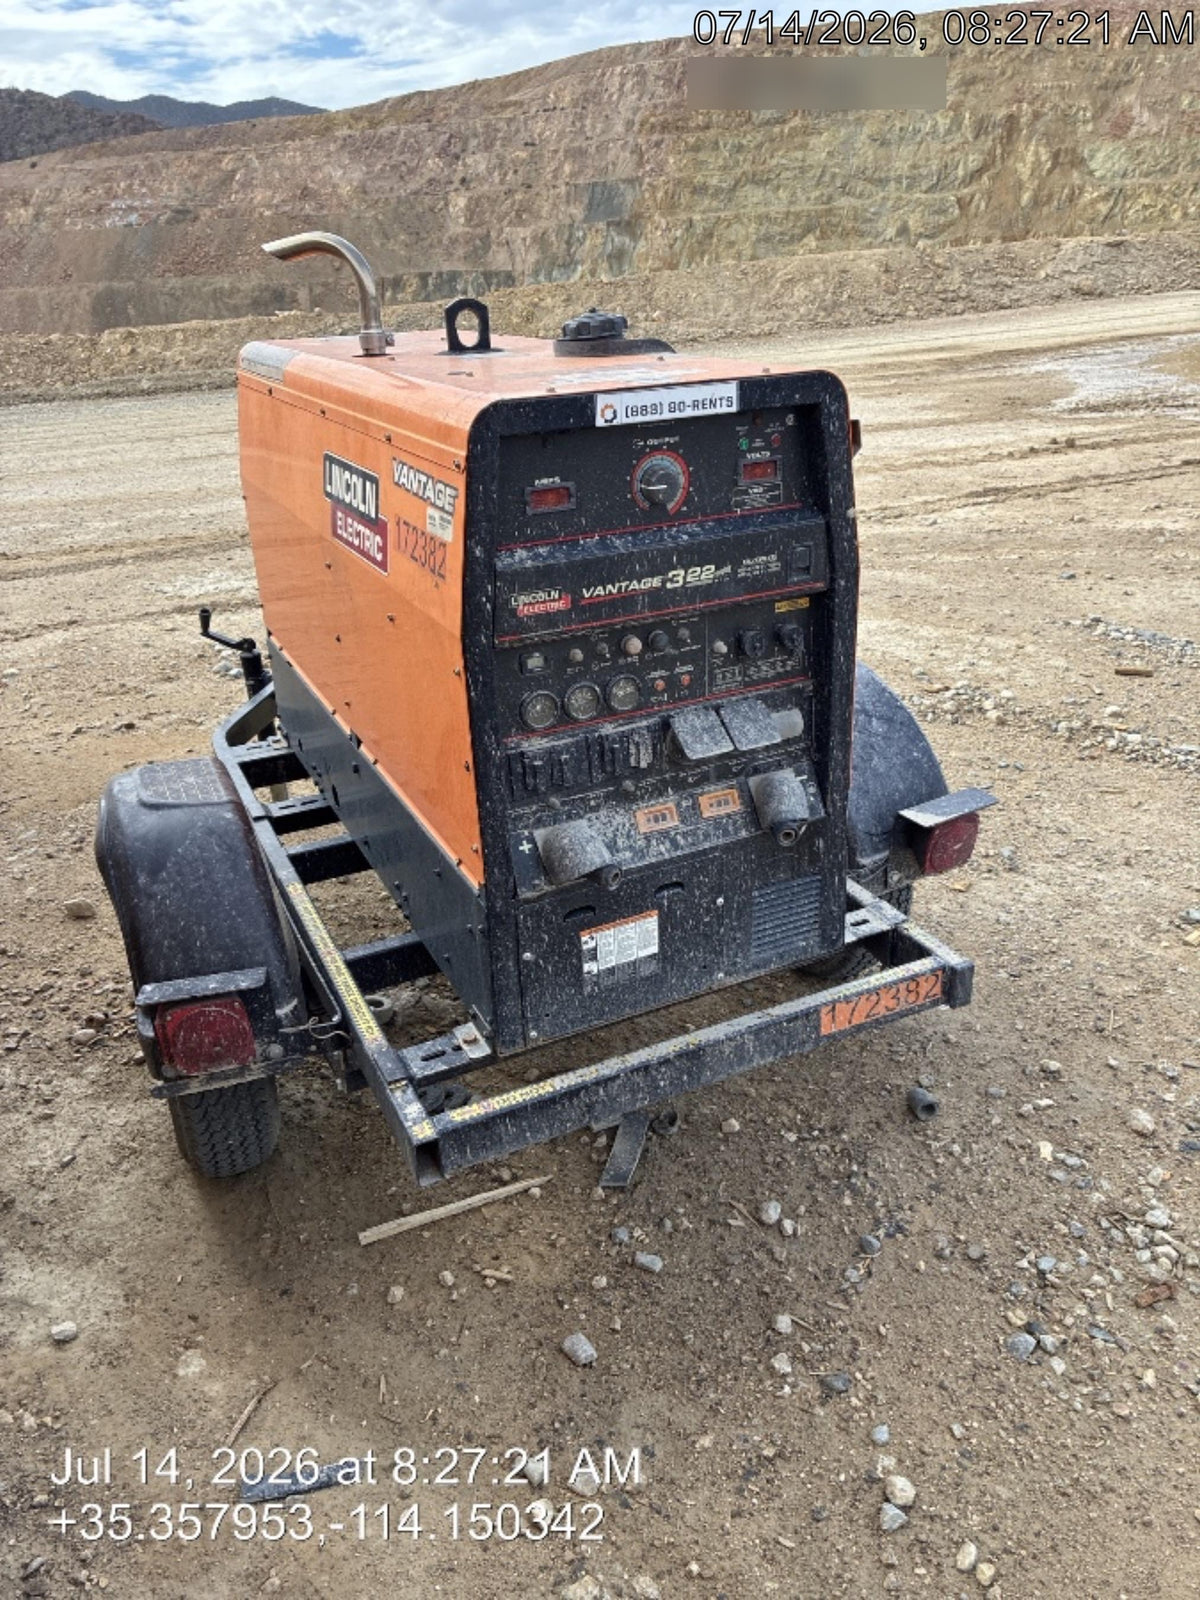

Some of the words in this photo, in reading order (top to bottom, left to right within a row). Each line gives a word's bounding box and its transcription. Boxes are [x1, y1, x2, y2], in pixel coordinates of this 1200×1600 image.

[624, 401, 664, 418] (888)
[324, 459, 377, 520] LINCOLN
[392, 458, 458, 514] VANTAGE
[335, 511, 383, 562] ELECTRIC
[394, 515, 447, 580] 172382
[510, 589, 560, 606] LINCOLN
[523, 600, 567, 614] ELECTRIC
[582, 575, 663, 599] VANTAGE
[666, 565, 716, 589] 322
[821, 973, 940, 1026] 172382
